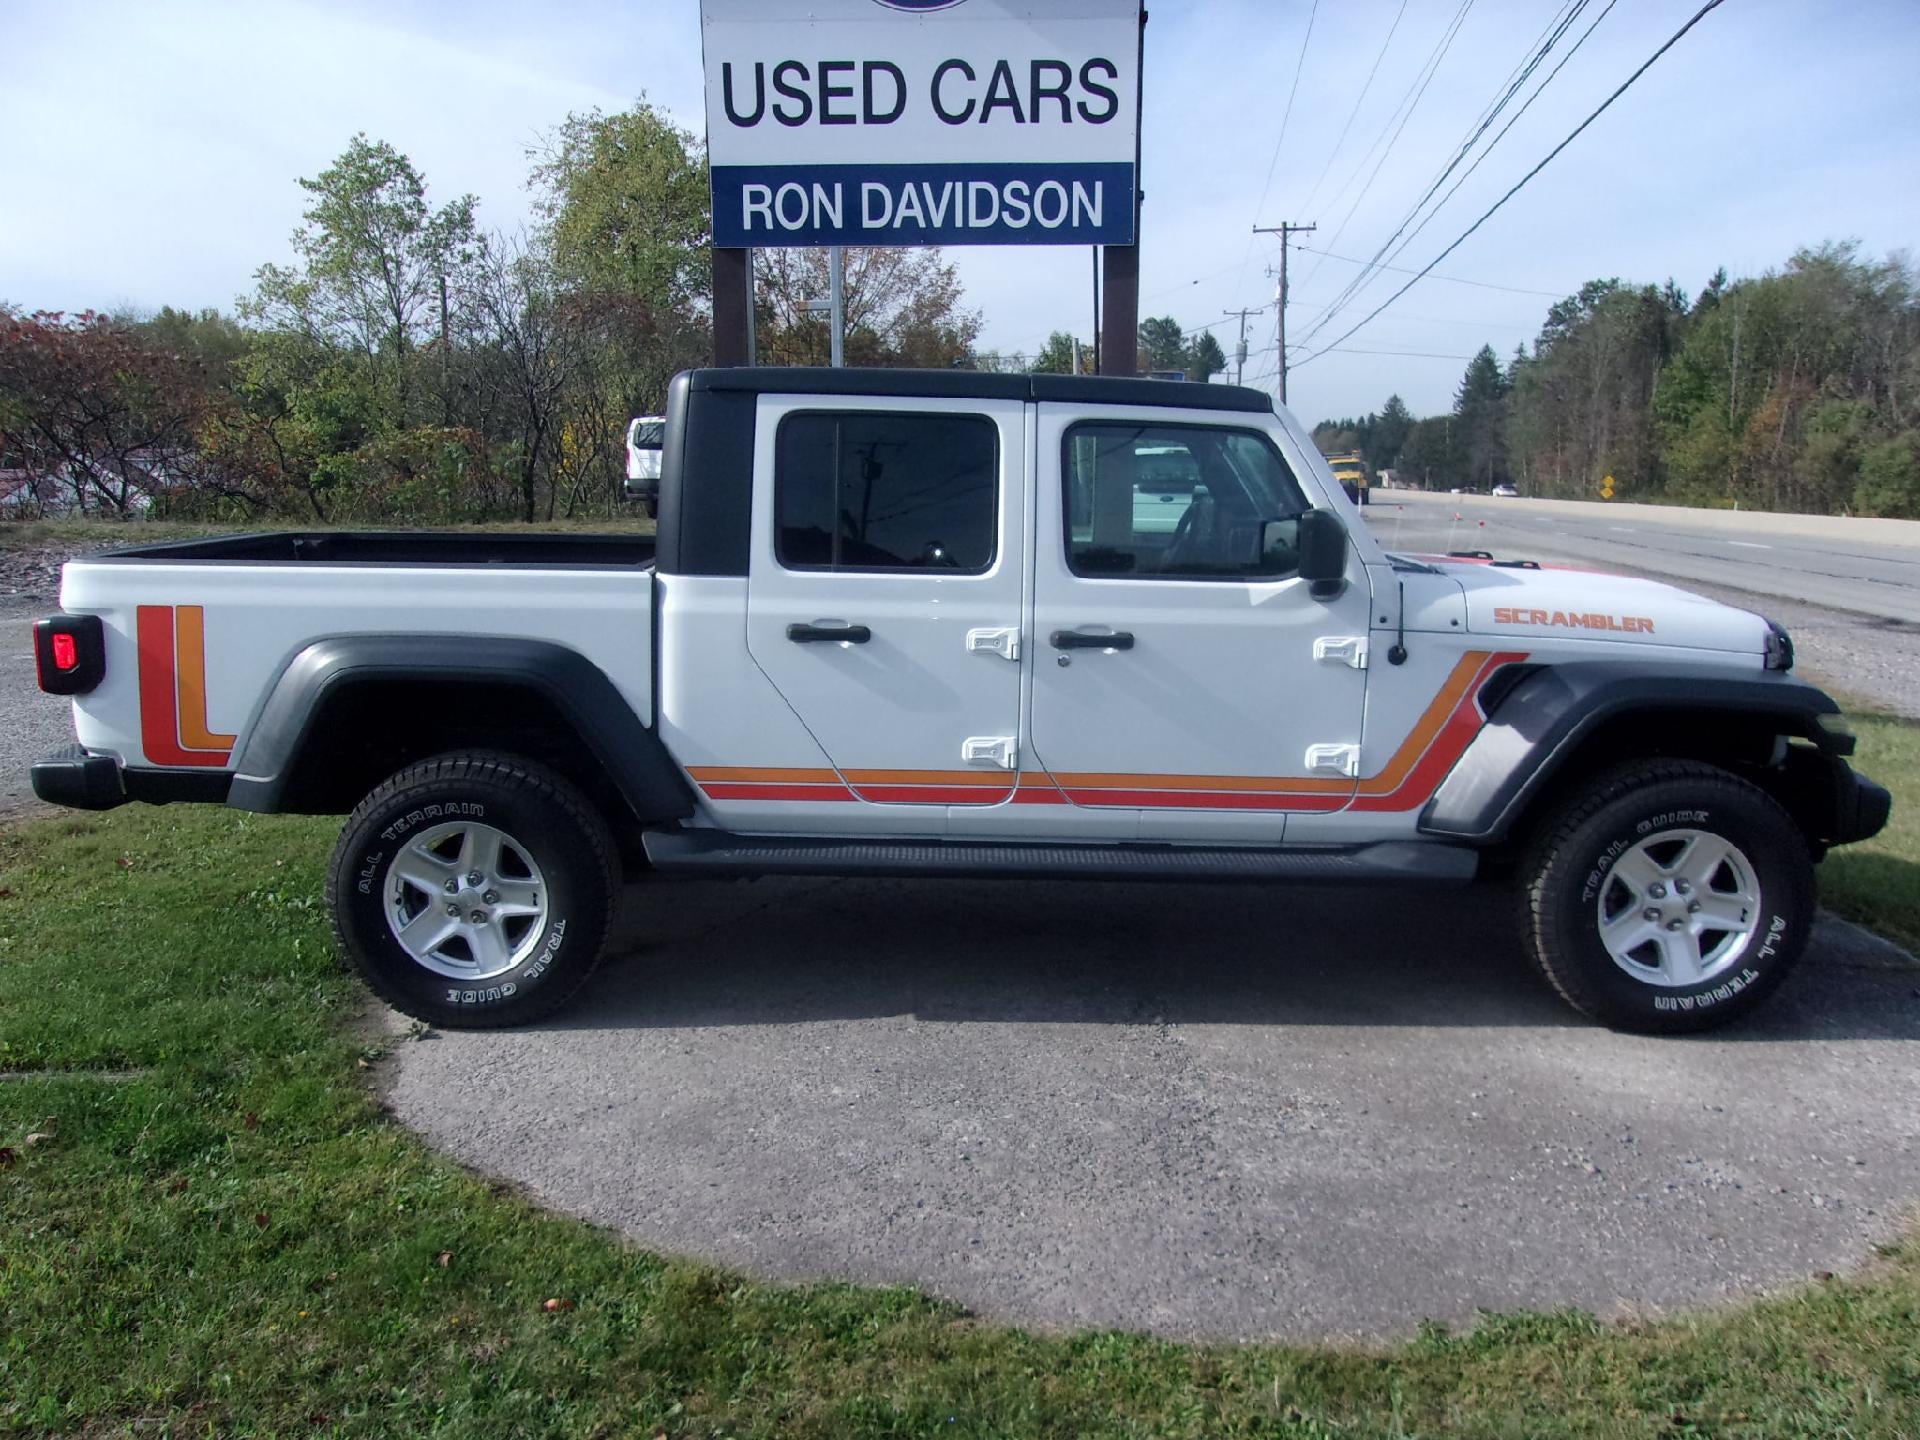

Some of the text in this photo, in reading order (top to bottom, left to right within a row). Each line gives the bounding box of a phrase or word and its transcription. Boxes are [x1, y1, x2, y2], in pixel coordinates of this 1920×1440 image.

[722, 58, 1119, 128] USED CARS
[742, 181, 1103, 230] RON DAVIDSON
[1494, 607, 1655, 633] SCRAMBLER
[359, 802, 484, 894] ALL TERRAIN
[1582, 810, 1709, 903] TRAIL GUIDE
[446, 919, 567, 1003] TRAIL GUIDE
[1654, 915, 1786, 1011] ALL TERRAIN
